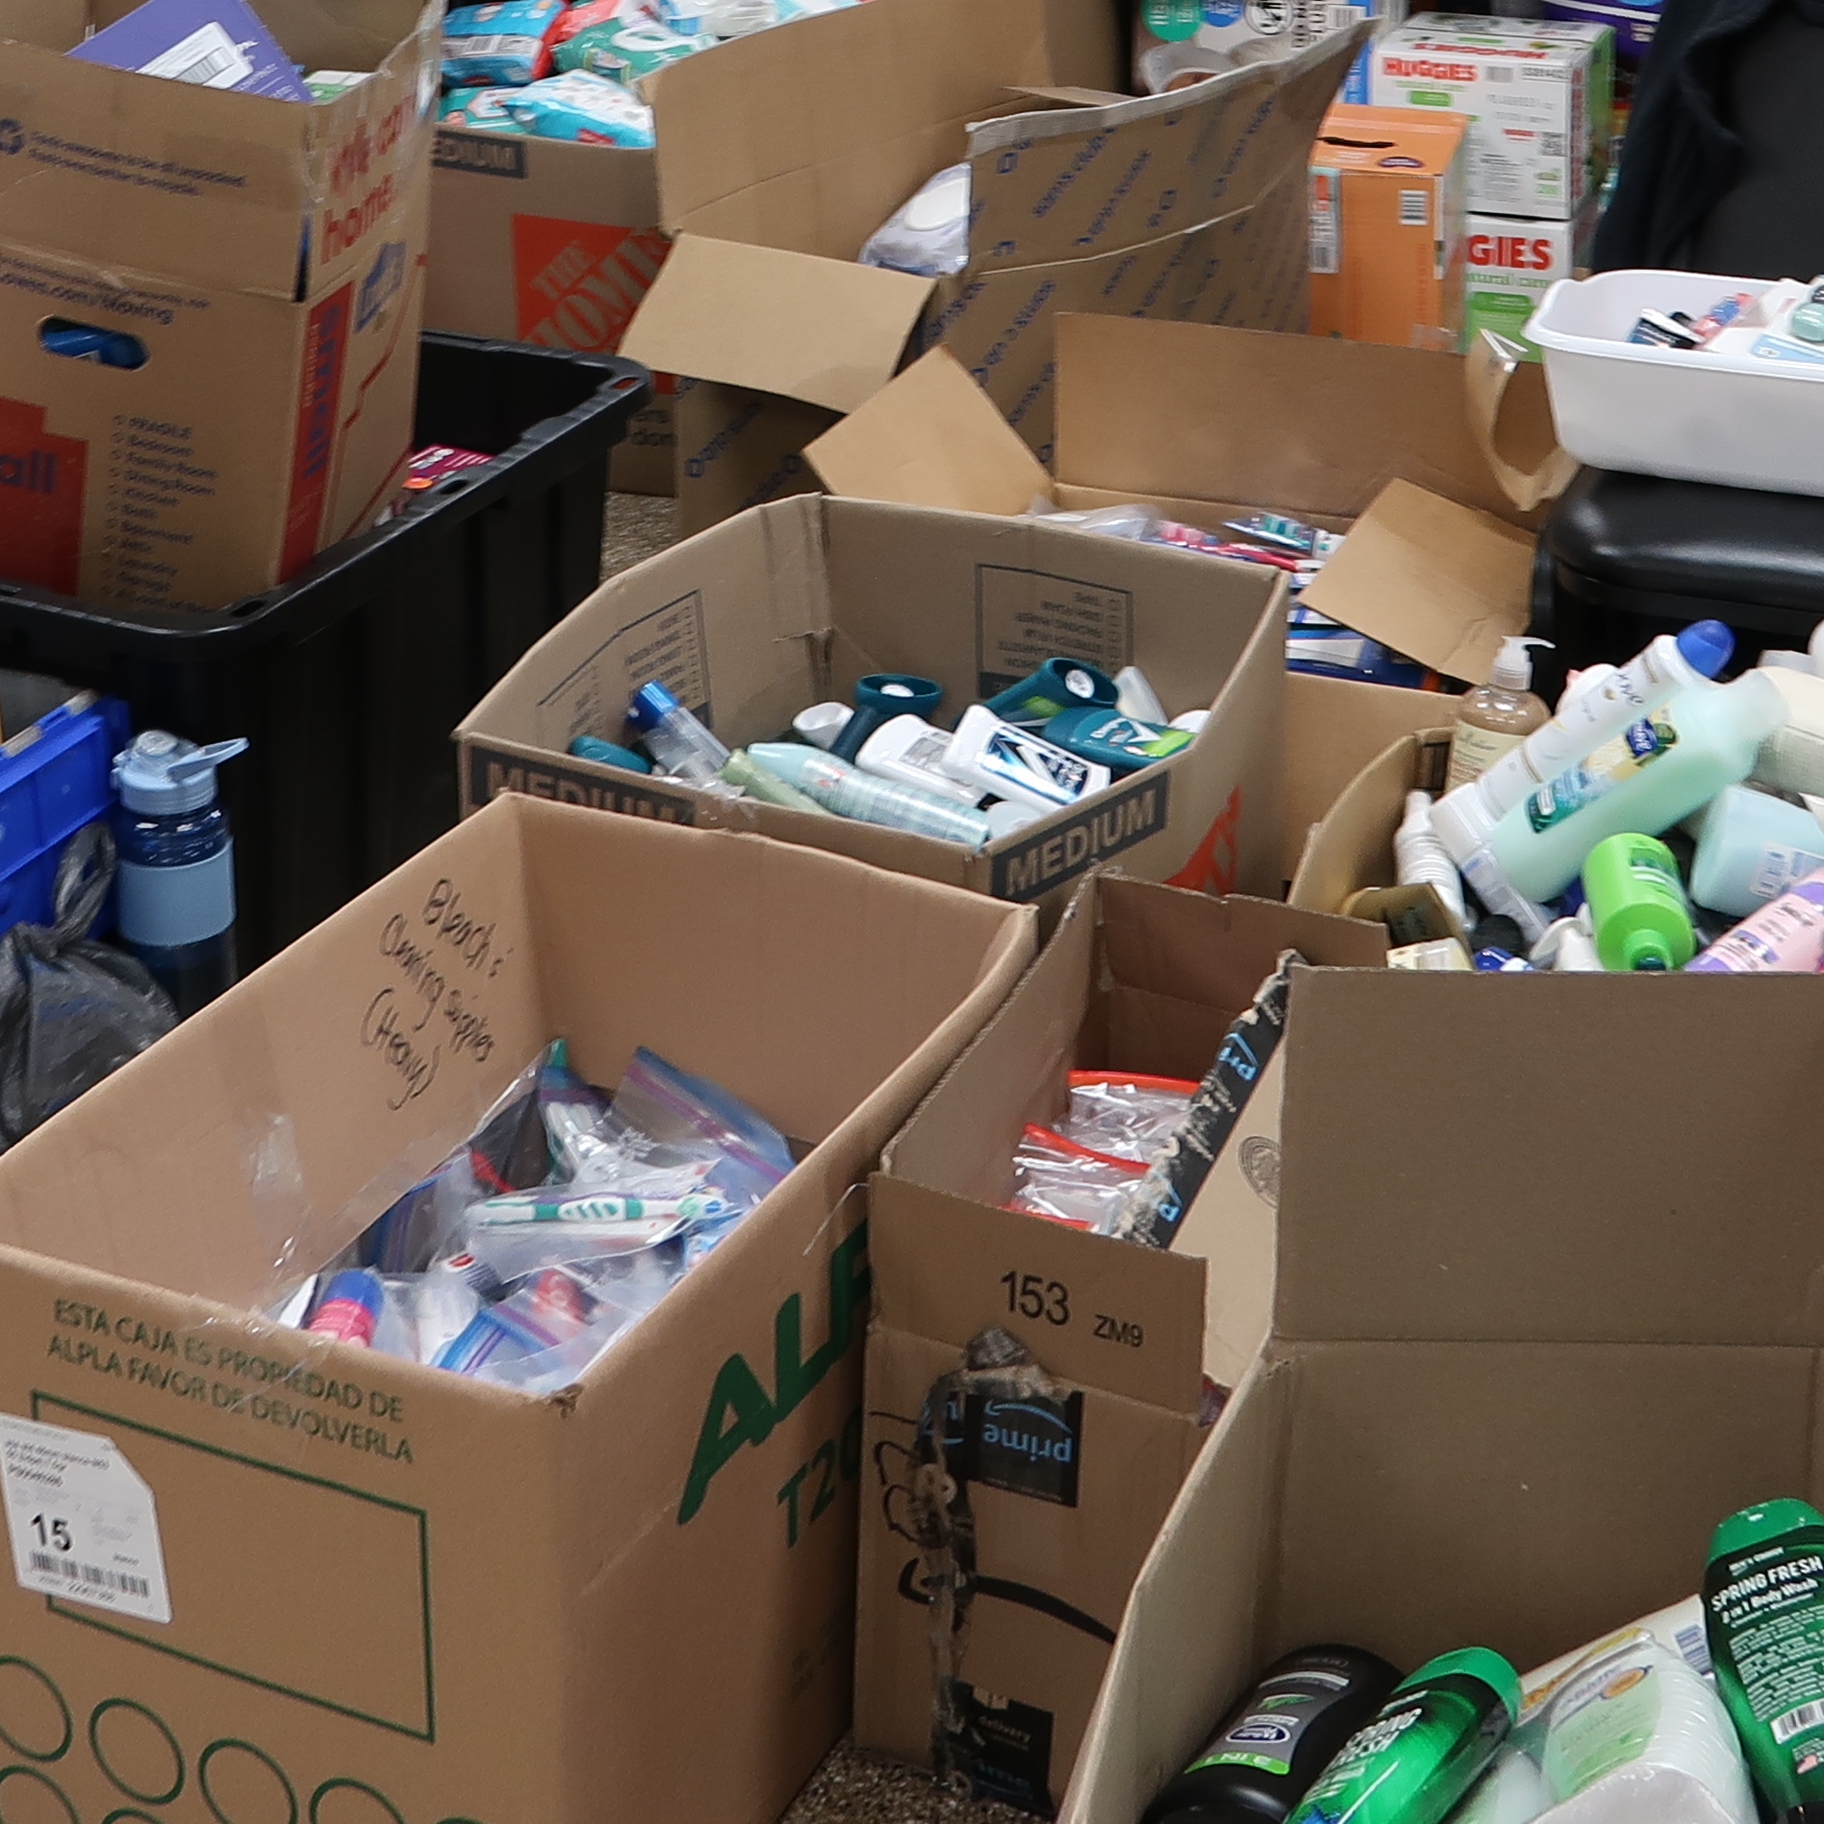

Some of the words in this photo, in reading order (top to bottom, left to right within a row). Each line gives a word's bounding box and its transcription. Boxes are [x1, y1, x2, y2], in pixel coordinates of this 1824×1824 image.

[1382, 56, 1479, 82] HUGGIES
[433, 136, 518, 170] EDIUM
[1466, 234, 1555, 271] GIES
[1004, 787, 1159, 901] MEDIUM
[999, 1268, 1071, 1327] 153
[1092, 1314, 1145, 1347] ZM9
[53, 1298, 111, 1337] ESTA
[112, 1314, 179, 1356] CAJA
[182, 1335, 215, 1368] ES
[216, 1345, 364, 1412] PROPIEDAD
[368, 1389, 404, 1424] DE
[47, 1334, 123, 1378] ALPLA
[126, 1355, 207, 1403] FAVOR
[209, 1380, 245, 1414] DE
[249, 1393, 415, 1464] DEVOLVERLA
[982, 1422, 1074, 1464] prime
[29, 1512, 74, 1553] 15
[1710, 1573, 1768, 1612] SPRING
[1767, 1555, 1824, 1585] FRESH
[1751, 1590, 1783, 1610] Body
[1780, 1577, 1820, 1597] Wash
